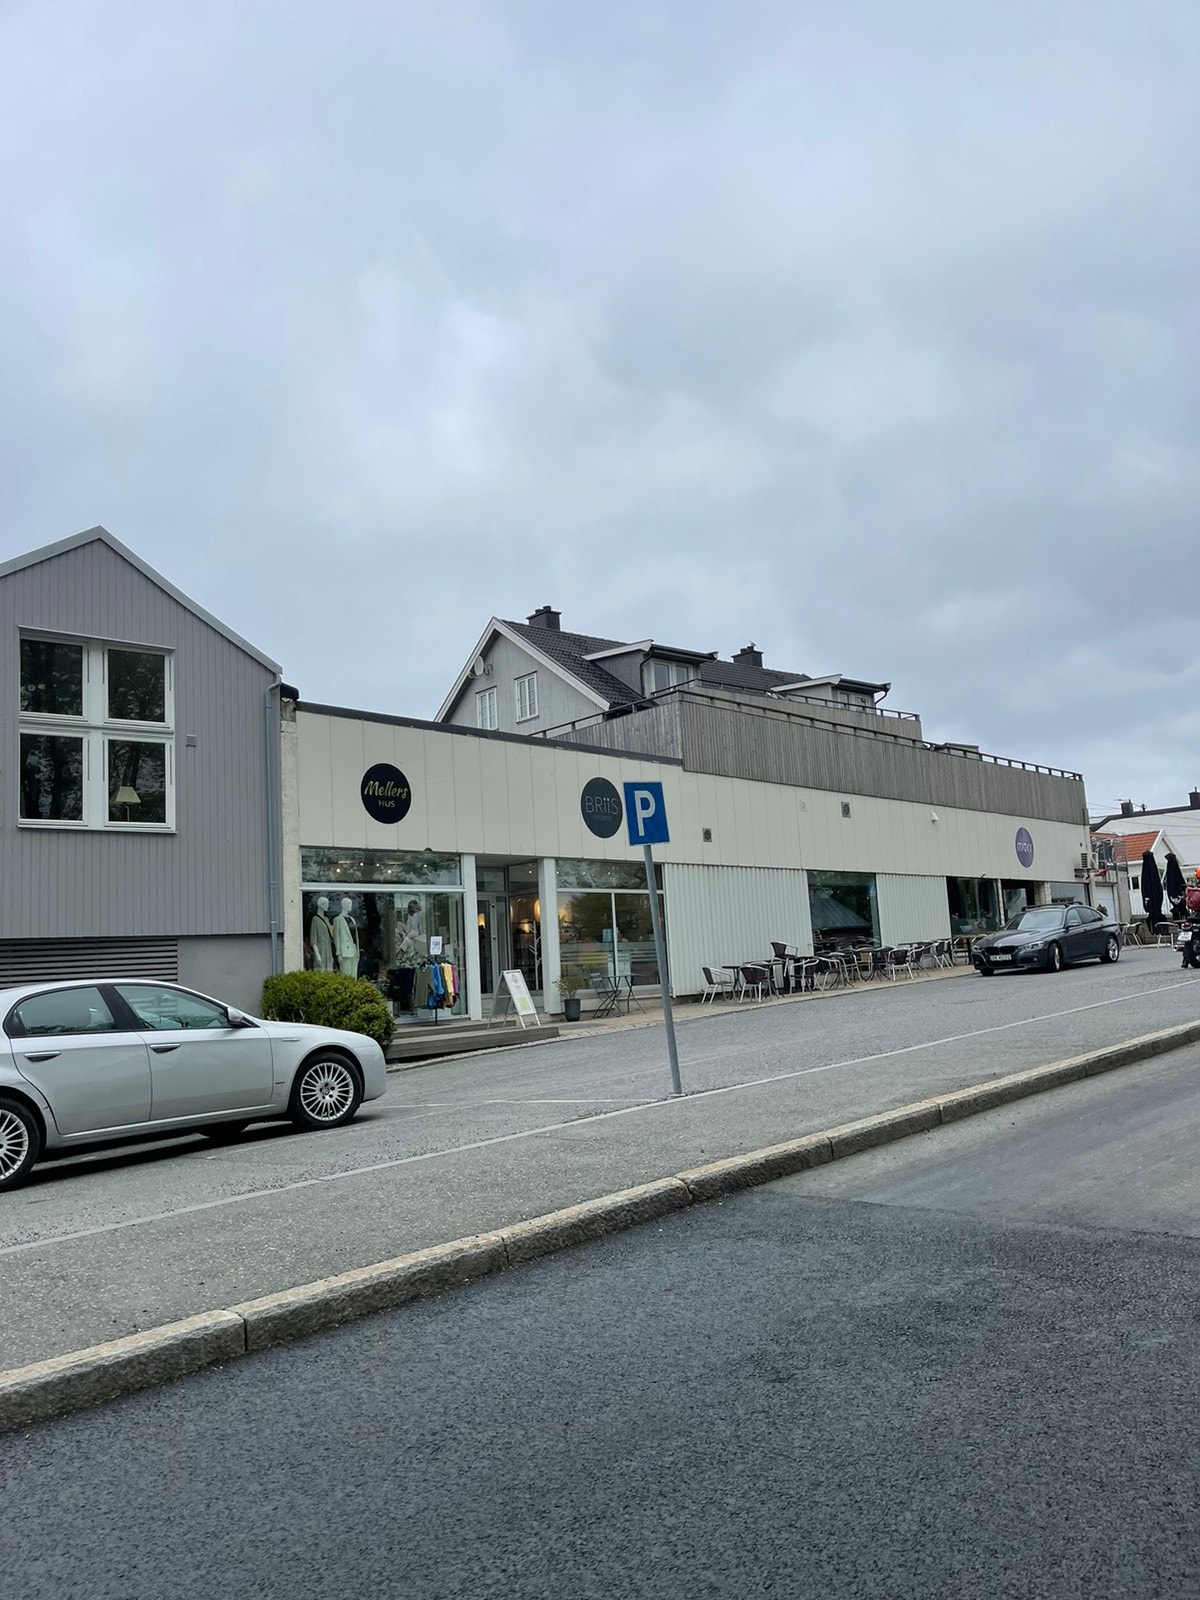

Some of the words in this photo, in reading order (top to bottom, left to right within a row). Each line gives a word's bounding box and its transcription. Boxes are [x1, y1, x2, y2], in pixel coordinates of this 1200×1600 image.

[364, 780, 409, 799] Mellers
[378, 800, 396, 808] HUS
[634, 790, 656, 836] P
